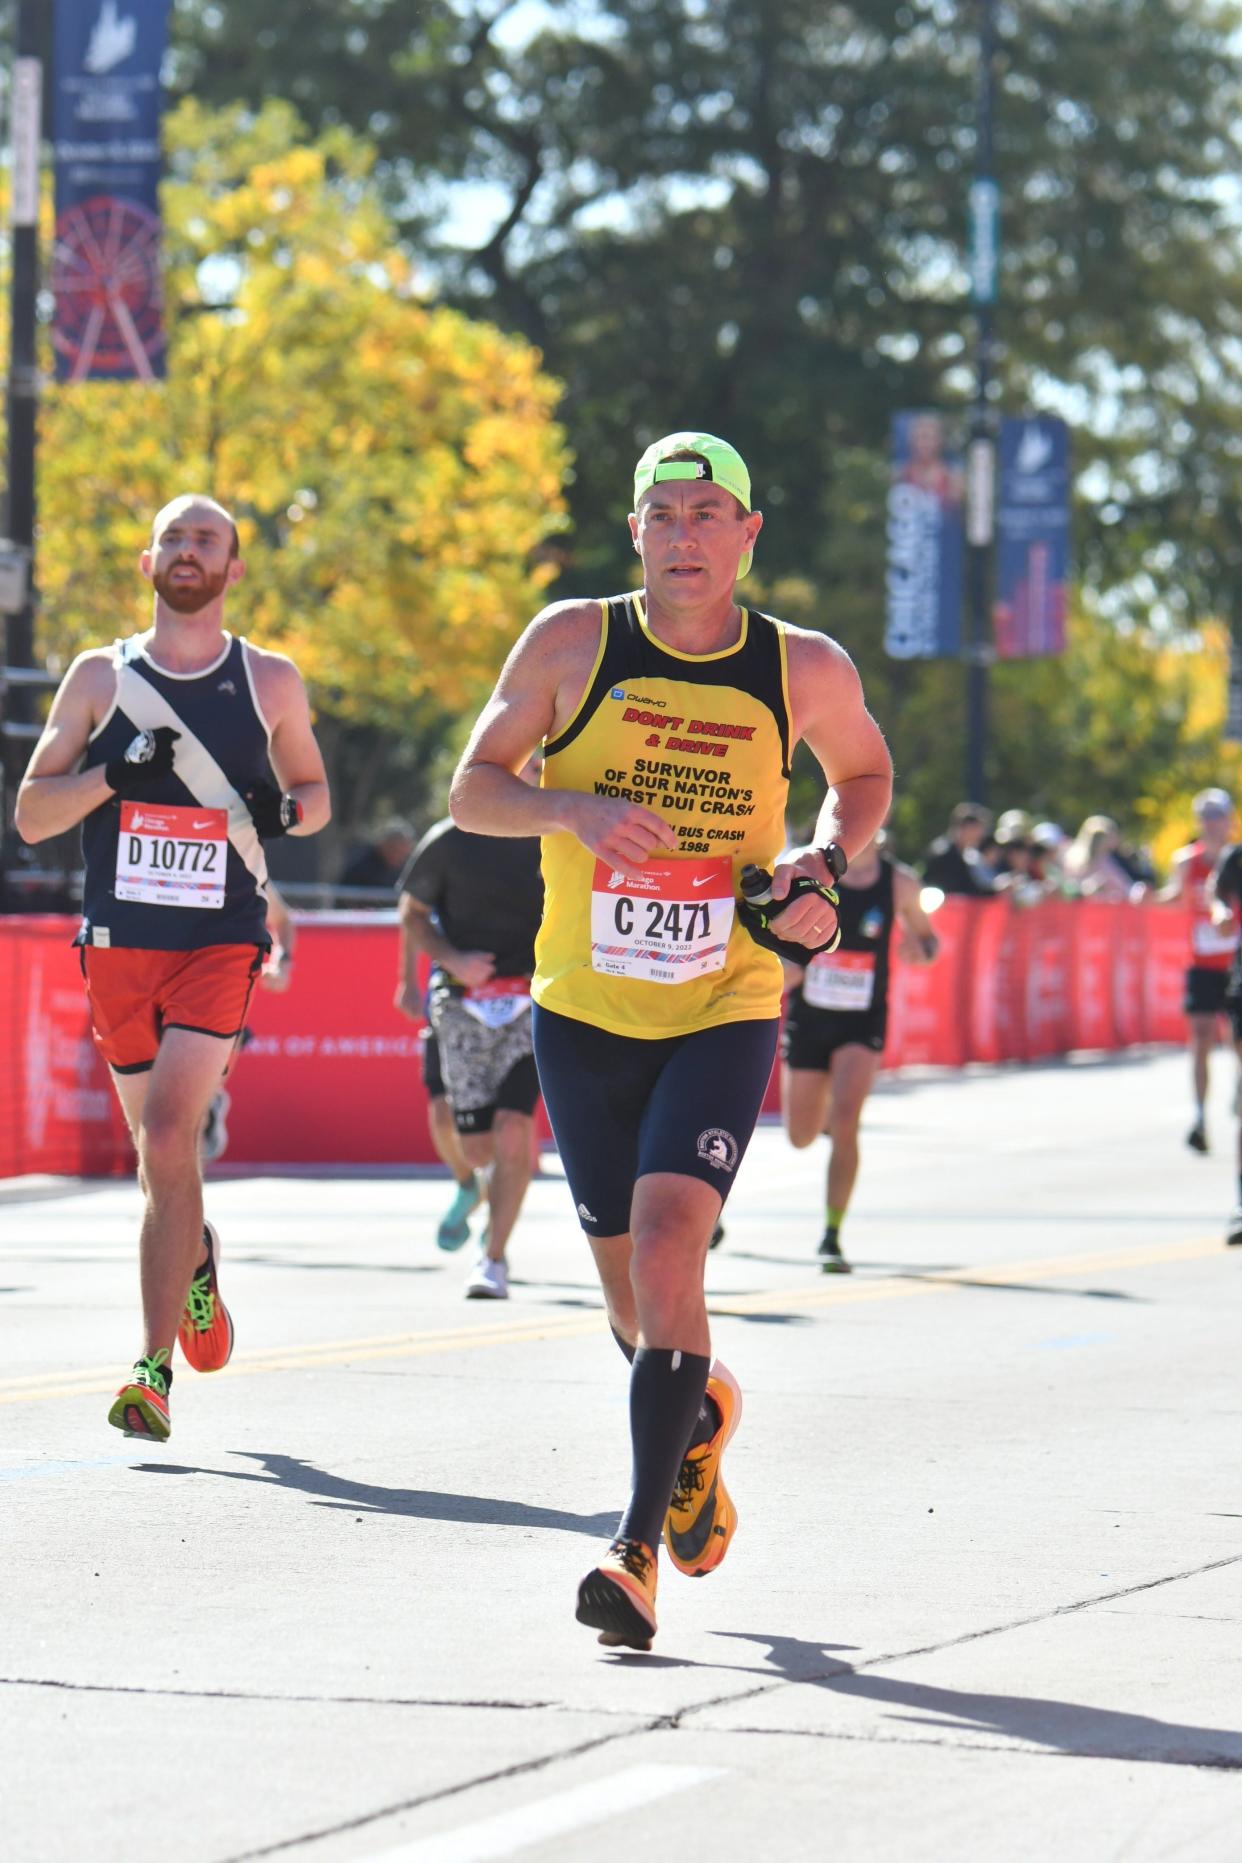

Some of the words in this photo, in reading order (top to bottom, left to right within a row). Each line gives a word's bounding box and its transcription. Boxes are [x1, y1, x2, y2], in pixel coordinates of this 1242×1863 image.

[622, 708, 684, 730] DON'T
[687, 720, 757, 741] DRINK
[645, 734, 661, 748] &
[665, 737, 729, 757] DRIVE
[634, 758, 731, 785] SURVIVOR
[604, 769, 627, 782] OF
[632, 774, 669, 791] OUR
[674, 780, 753, 802] NATION'S
[594, 782, 657, 803] WORST
[662, 794, 695, 811] DUI
[700, 799, 756, 816] CRASH
[678, 825, 703, 838] BUS
[706, 827, 745, 841] CRASH
[128, 836, 142, 865] D
[149, 839, 217, 873] 10772
[678, 841, 710, 853] 1988
[626, 882, 661, 892] Marathon
[614, 897, 634, 936] C
[645, 901, 711, 942] 2471
[634, 939, 666, 950] OCTOBER
[285, 1036, 315, 1055] OF
